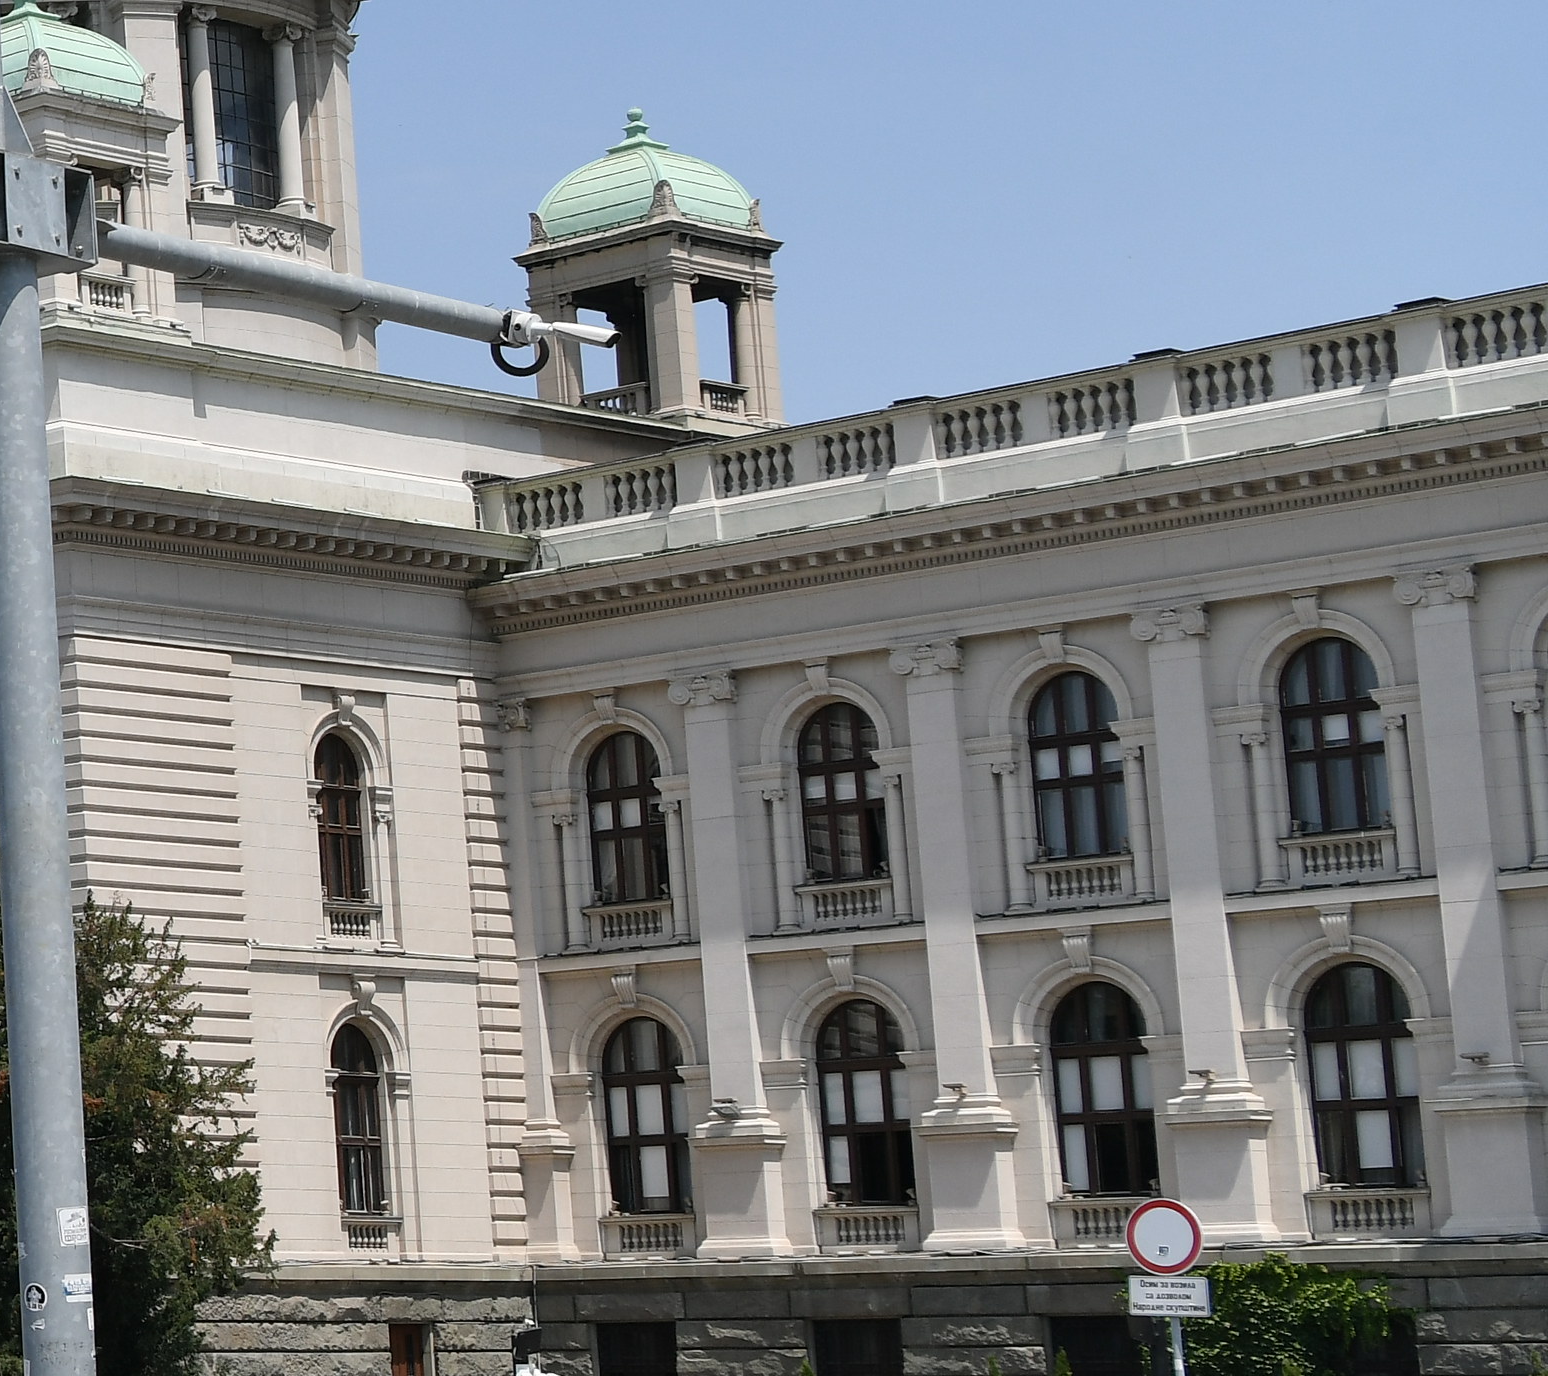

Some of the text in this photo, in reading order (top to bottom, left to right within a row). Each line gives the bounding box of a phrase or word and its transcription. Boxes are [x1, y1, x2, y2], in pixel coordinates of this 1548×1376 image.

[1140, 1279, 1158, 1288] Осим
[1133, 1302, 1206, 1313] Народне скупштине
